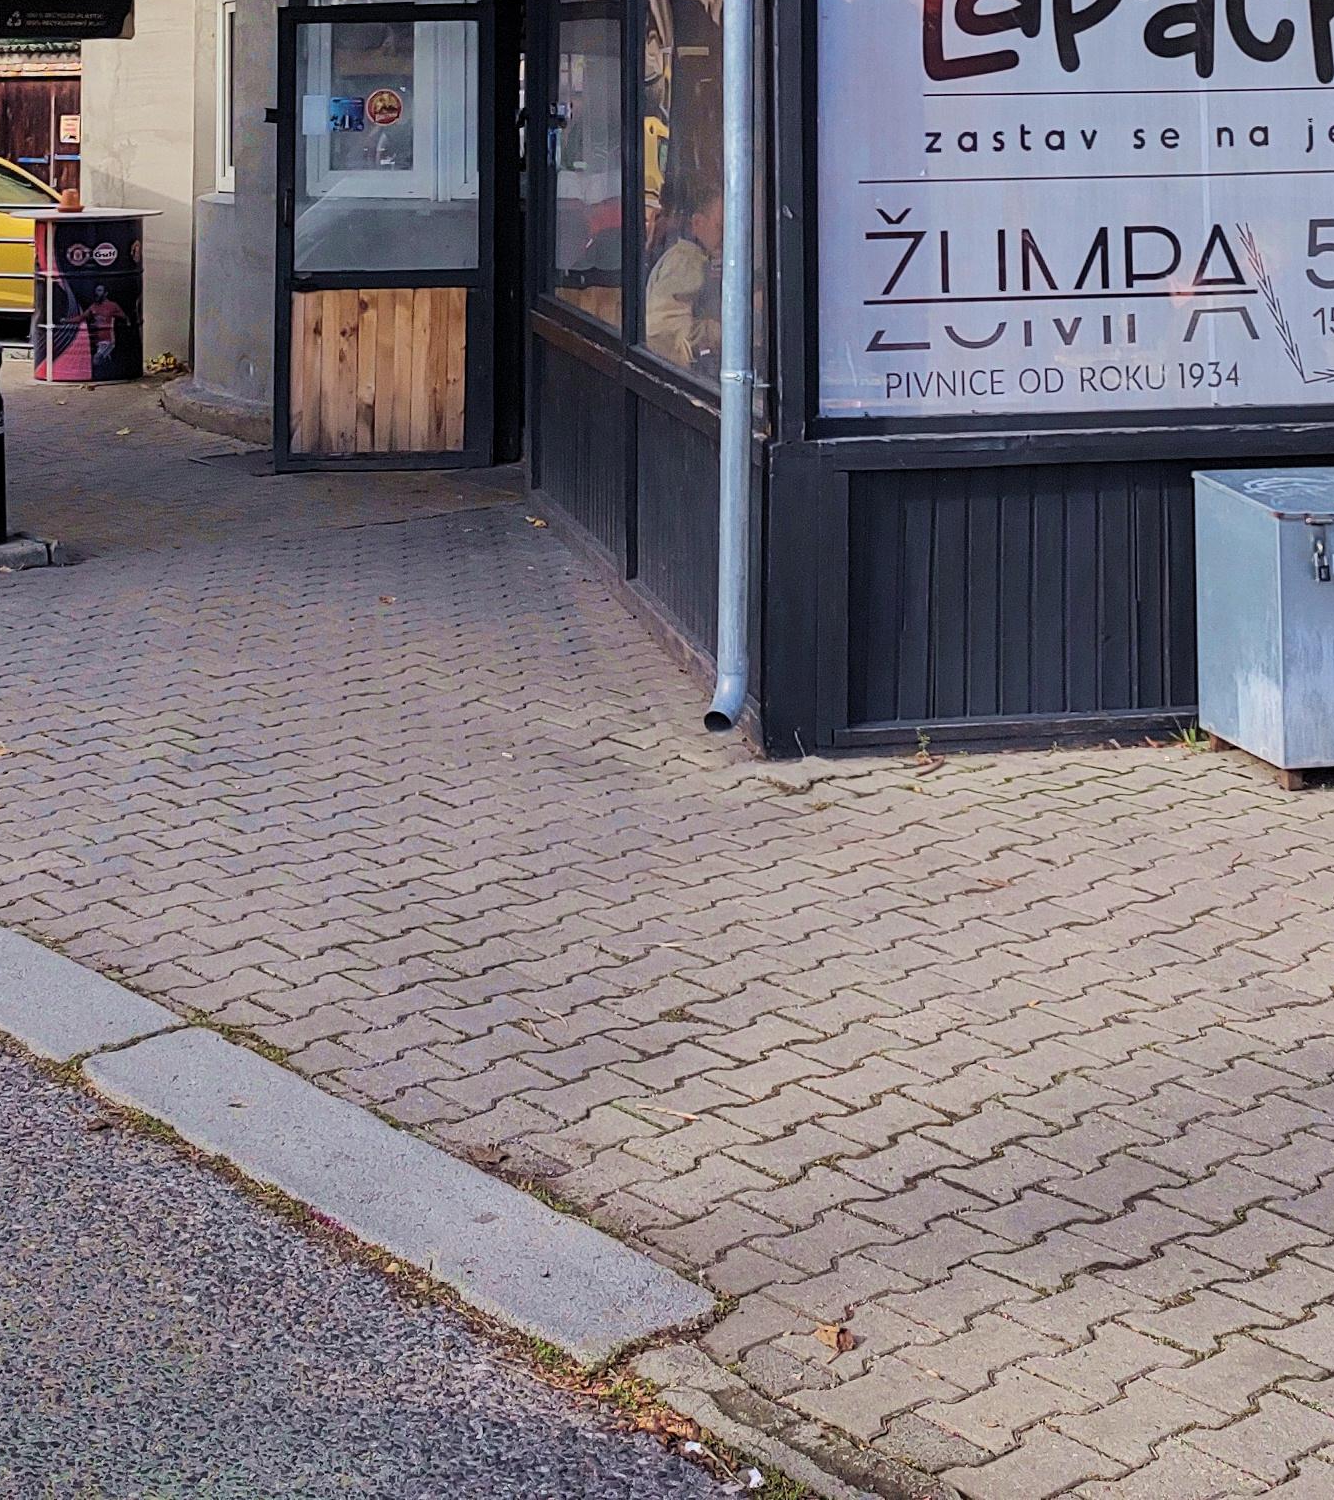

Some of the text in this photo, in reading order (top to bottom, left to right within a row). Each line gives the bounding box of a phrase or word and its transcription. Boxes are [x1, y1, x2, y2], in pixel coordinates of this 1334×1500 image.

[925, 127, 1098, 153] zastav
[1133, 126, 1180, 150] se
[1216, 124, 1270, 148] na
[886, 361, 1240, 399] PIVNICE OD ROKU 1934
